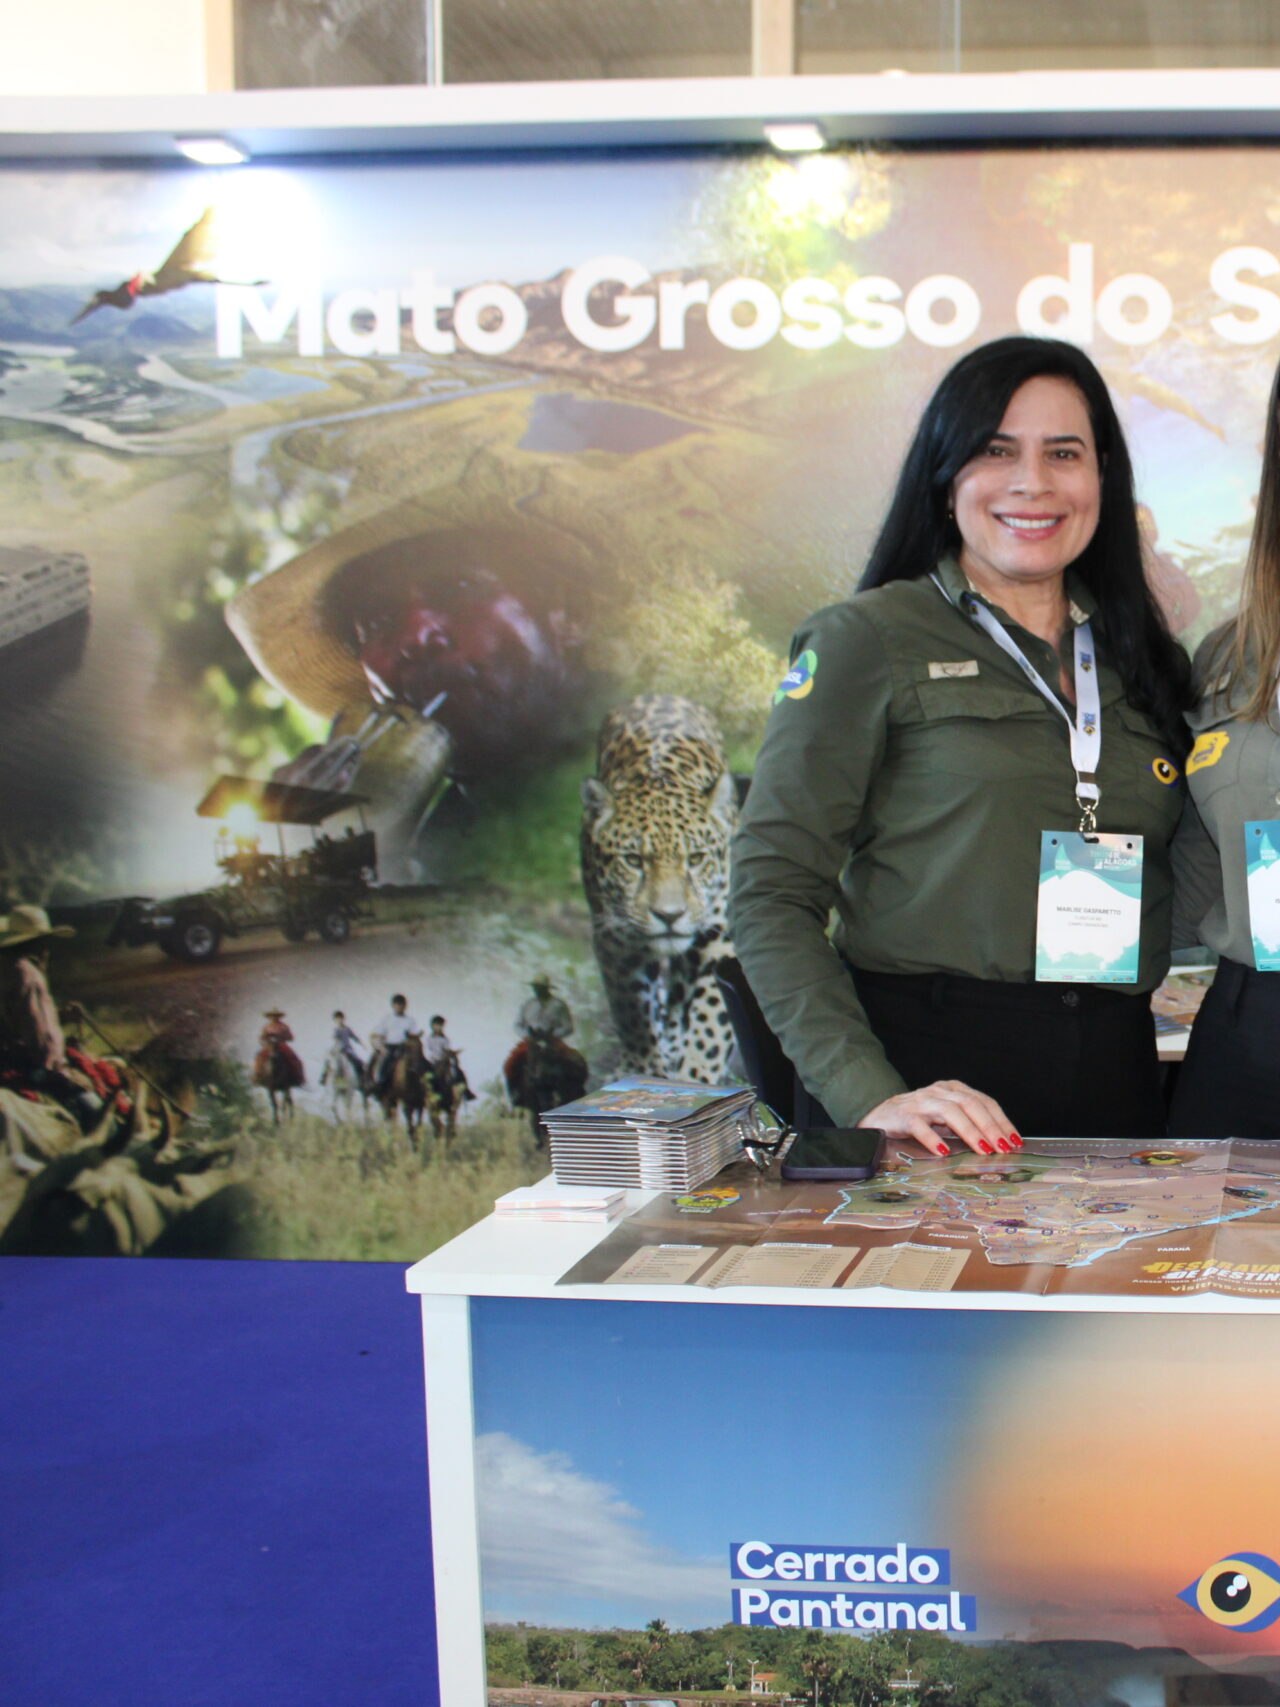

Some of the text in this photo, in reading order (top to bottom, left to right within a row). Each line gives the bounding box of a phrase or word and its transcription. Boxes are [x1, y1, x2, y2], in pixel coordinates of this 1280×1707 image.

[216, 269, 528, 358] Mato
[562, 254, 981, 352] Grosso
[1016, 243, 1174, 345] do
[737, 1541, 940, 1584] Cerrado
[740, 1588, 966, 1630] Pantanal
